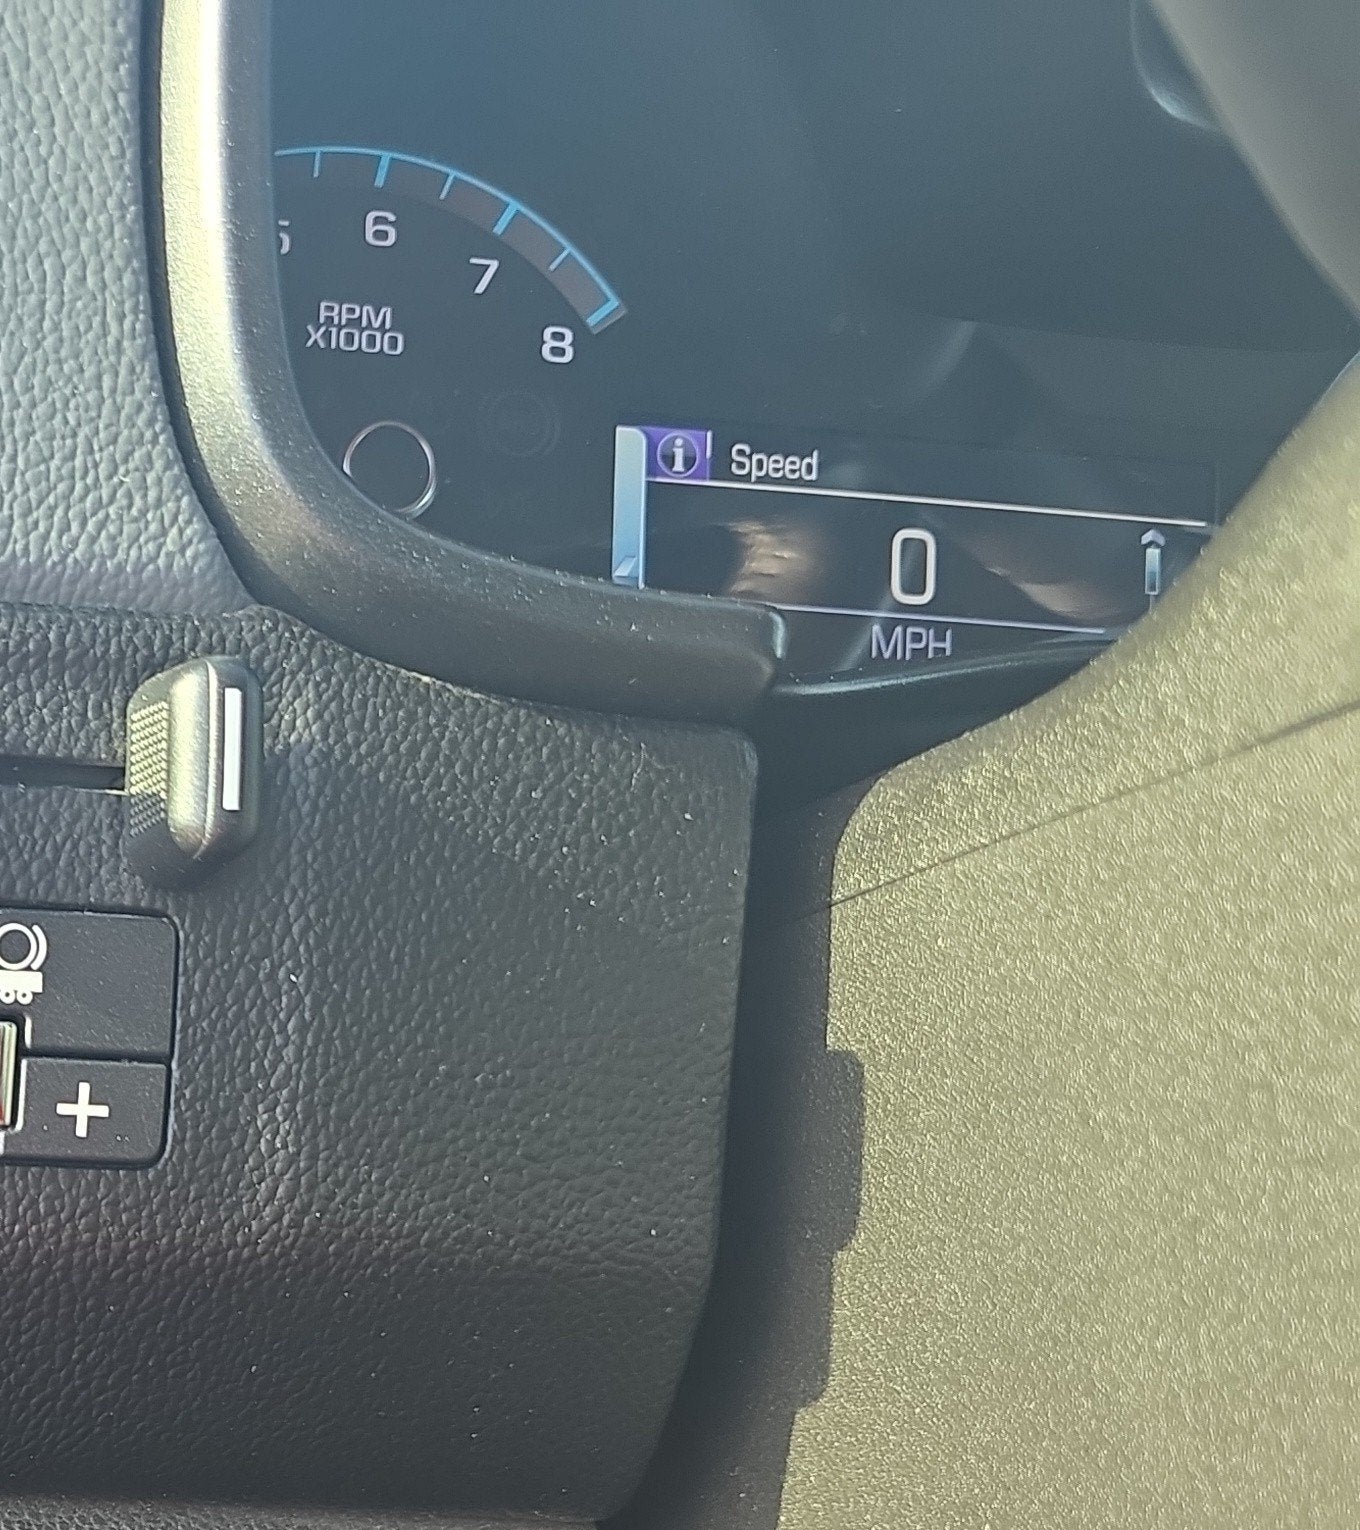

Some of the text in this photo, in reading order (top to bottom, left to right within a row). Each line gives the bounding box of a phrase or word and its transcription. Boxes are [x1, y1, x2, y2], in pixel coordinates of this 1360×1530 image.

[365, 210, 397, 247] 6
[469, 257, 500, 294] 7
[319, 302, 392, 329] RPM
[305, 324, 405, 356] X1000
[541, 326, 574, 364] 8
[730, 443, 819, 482] Speed
[891, 528, 937, 606] 0
[871, 624, 953, 661] MPH
